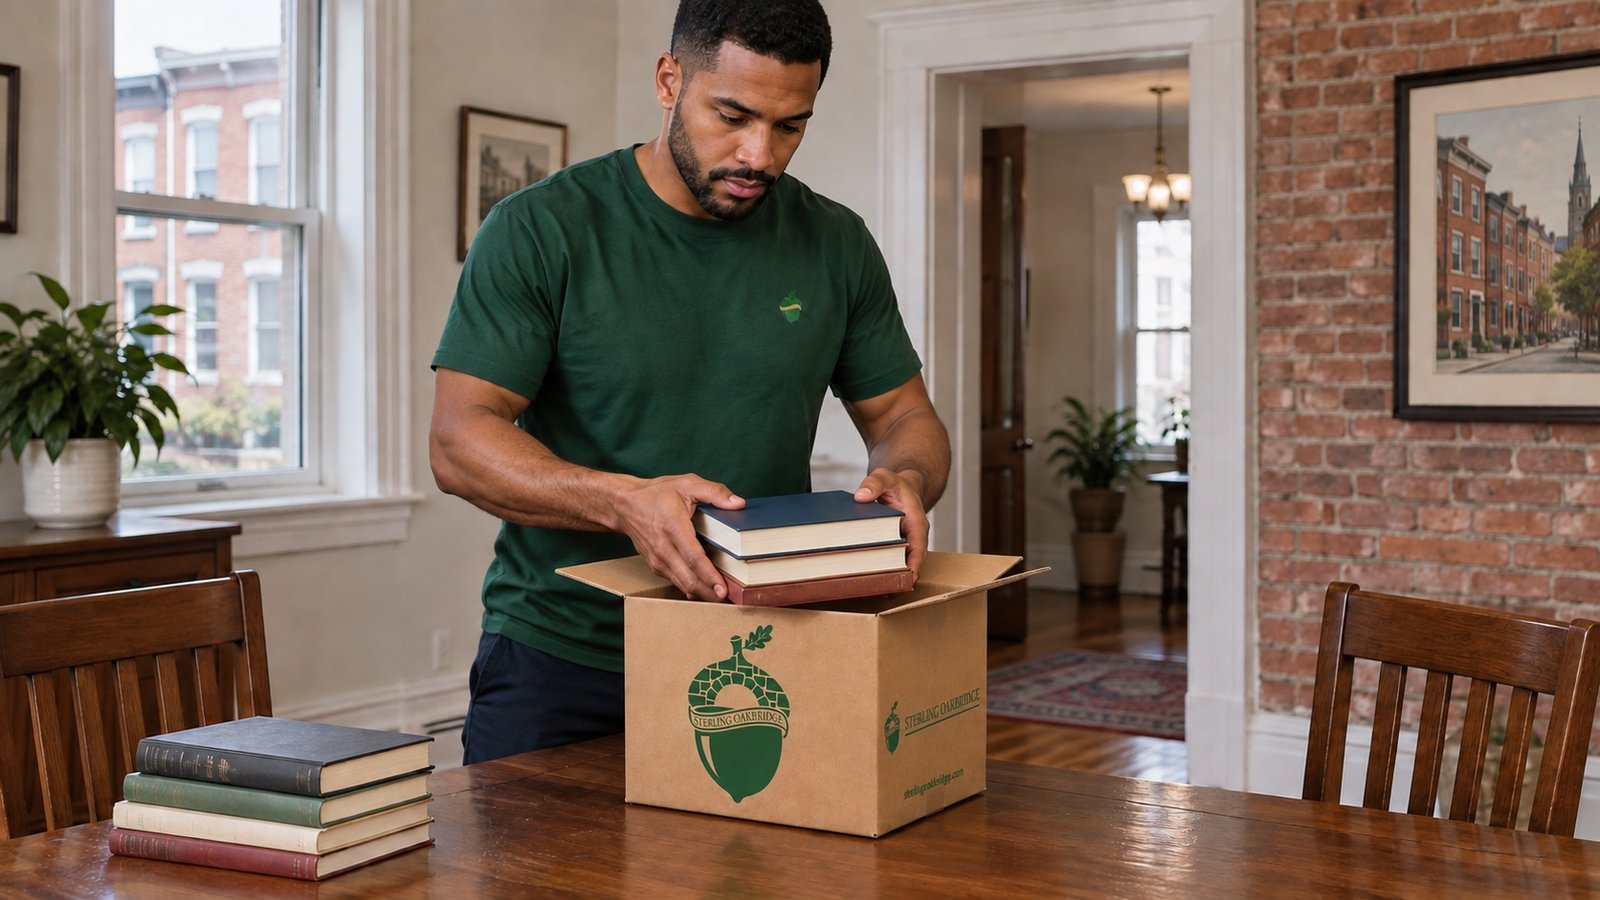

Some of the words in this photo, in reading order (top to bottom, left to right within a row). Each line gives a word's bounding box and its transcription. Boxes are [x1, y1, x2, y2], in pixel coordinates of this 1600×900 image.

[693, 715, 732, 728] STERLING
[733, 710, 783, 725] OAKBRIDGE
[904, 704, 940, 731] STERLING
[940, 687, 981, 716] OAKBRIDGE
